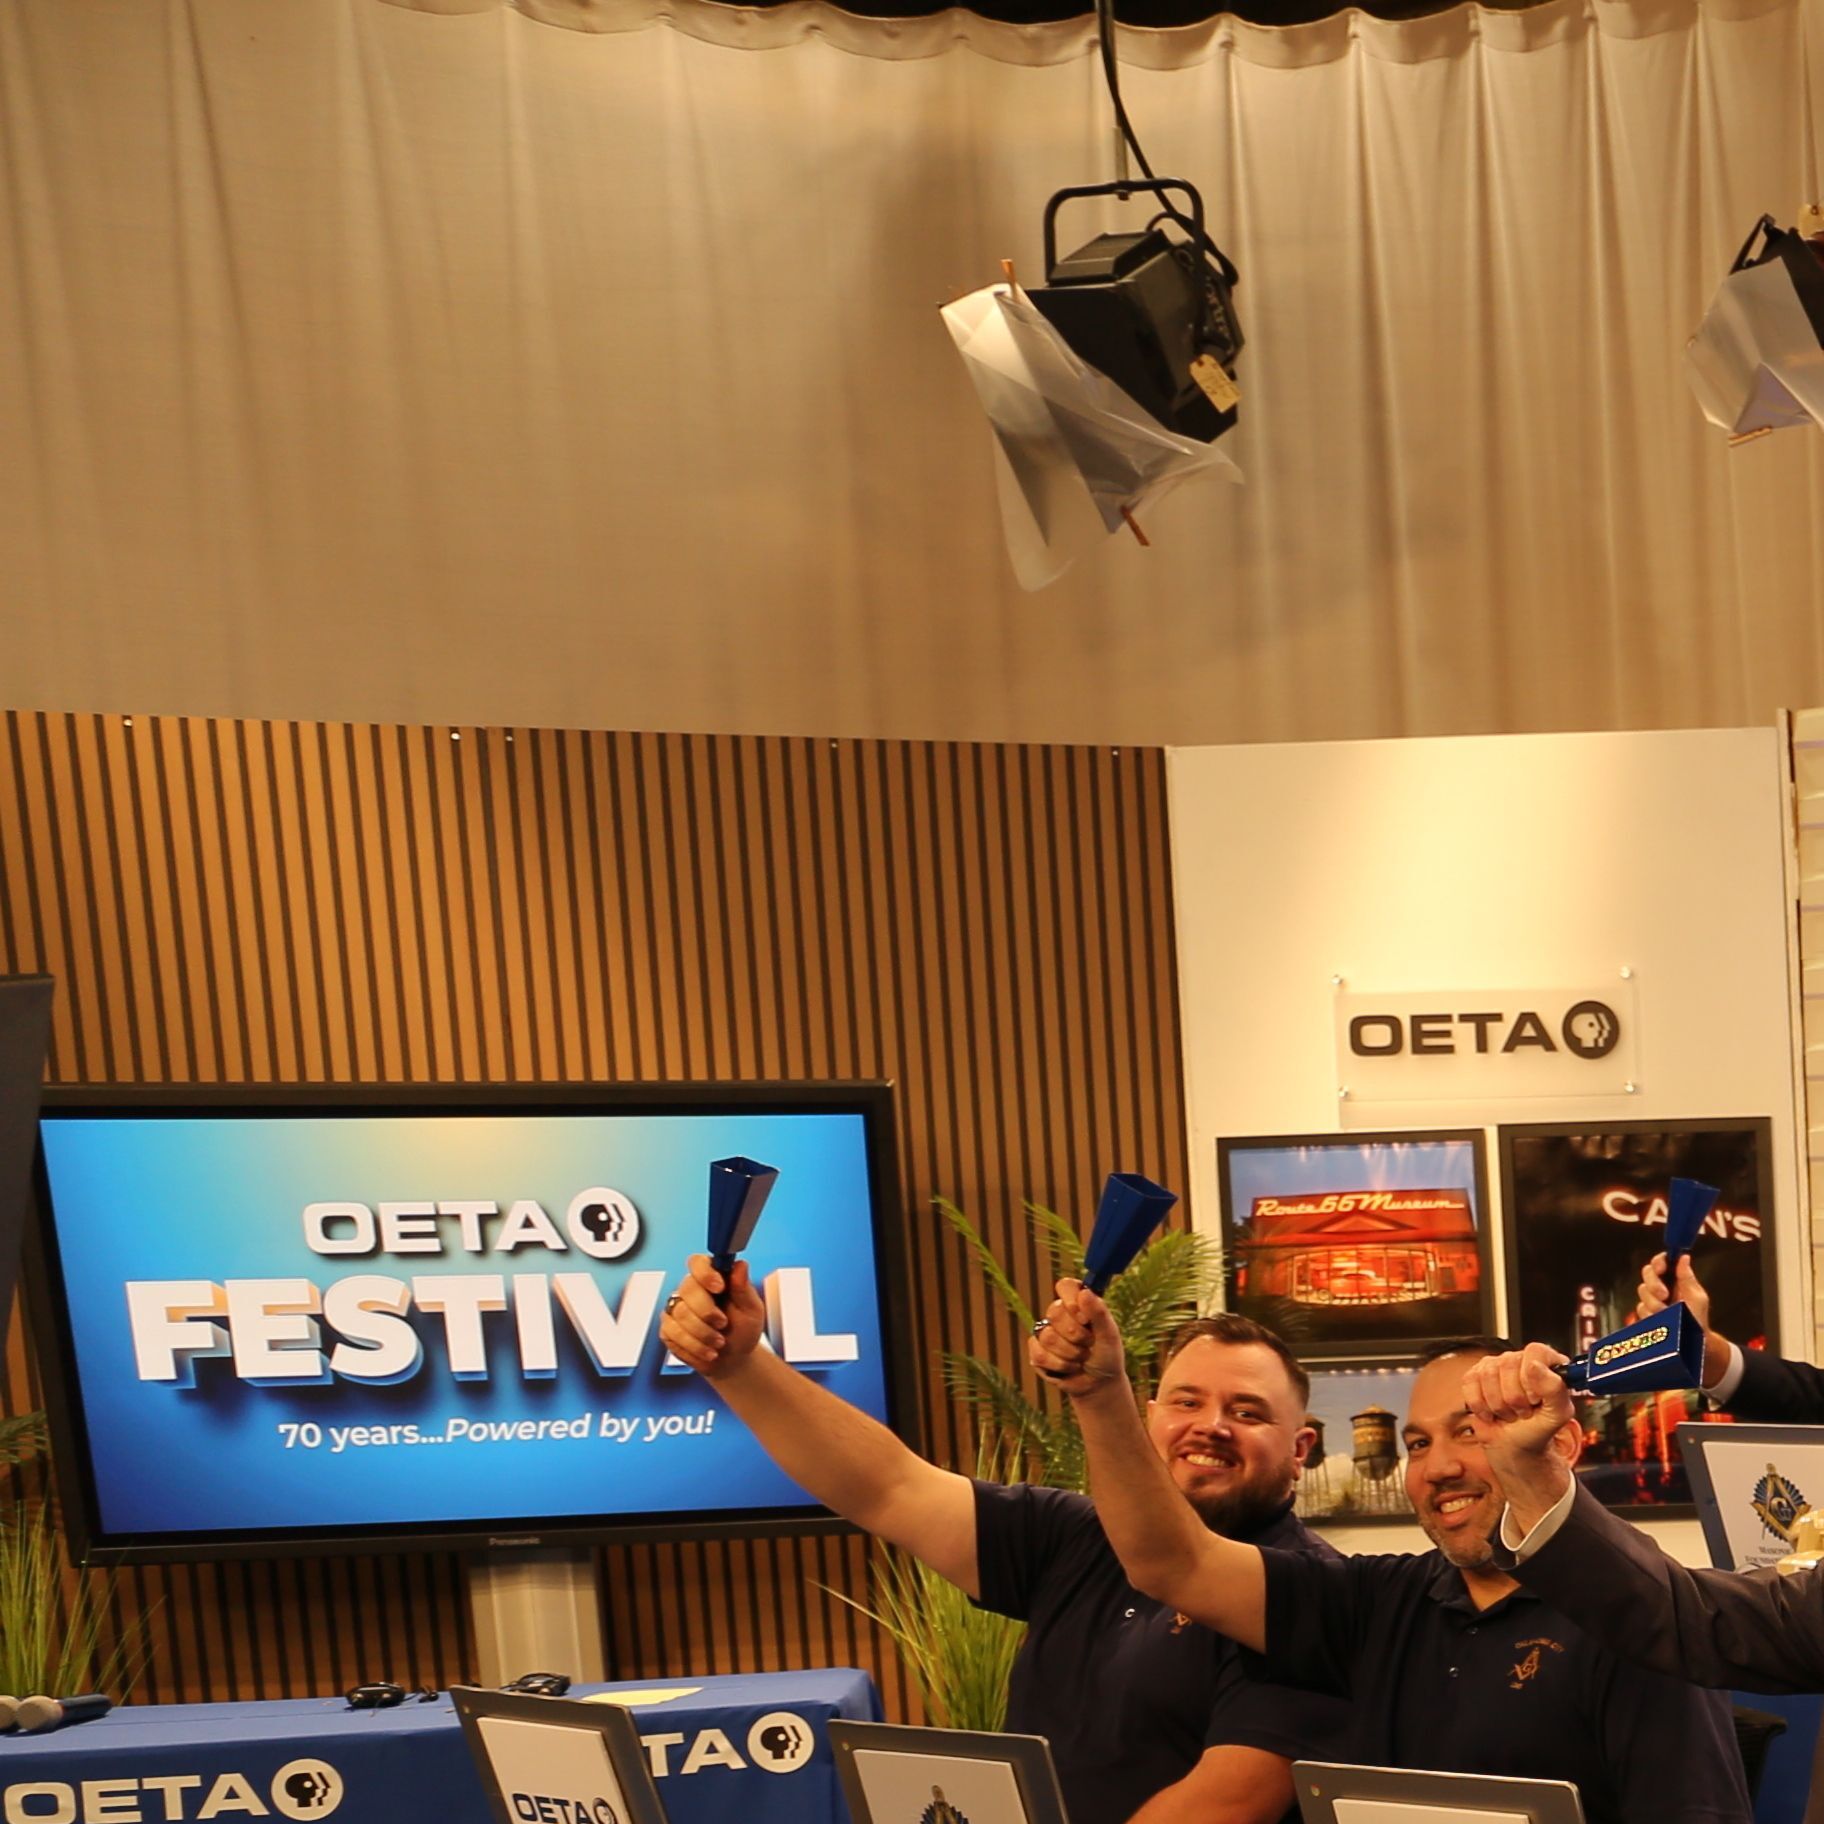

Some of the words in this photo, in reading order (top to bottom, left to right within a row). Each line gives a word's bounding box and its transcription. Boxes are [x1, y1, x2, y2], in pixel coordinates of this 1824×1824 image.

[1350, 1012, 1557, 1056] OETA
[302, 1201, 568, 1255] OETA
[1256, 1199, 1319, 1217] Route
[1319, 1195, 1356, 1213] 66
[1358, 1193, 1464, 1211] Museum
[1602, 1190, 1761, 1242] CAN'S
[124, 1268, 860, 1388] FESTIVL
[279, 1423, 321, 1449] 70
[599, 1412, 640, 1443] by
[643, 1410, 715, 1442] you!
[640, 1728, 748, 1778] TA
